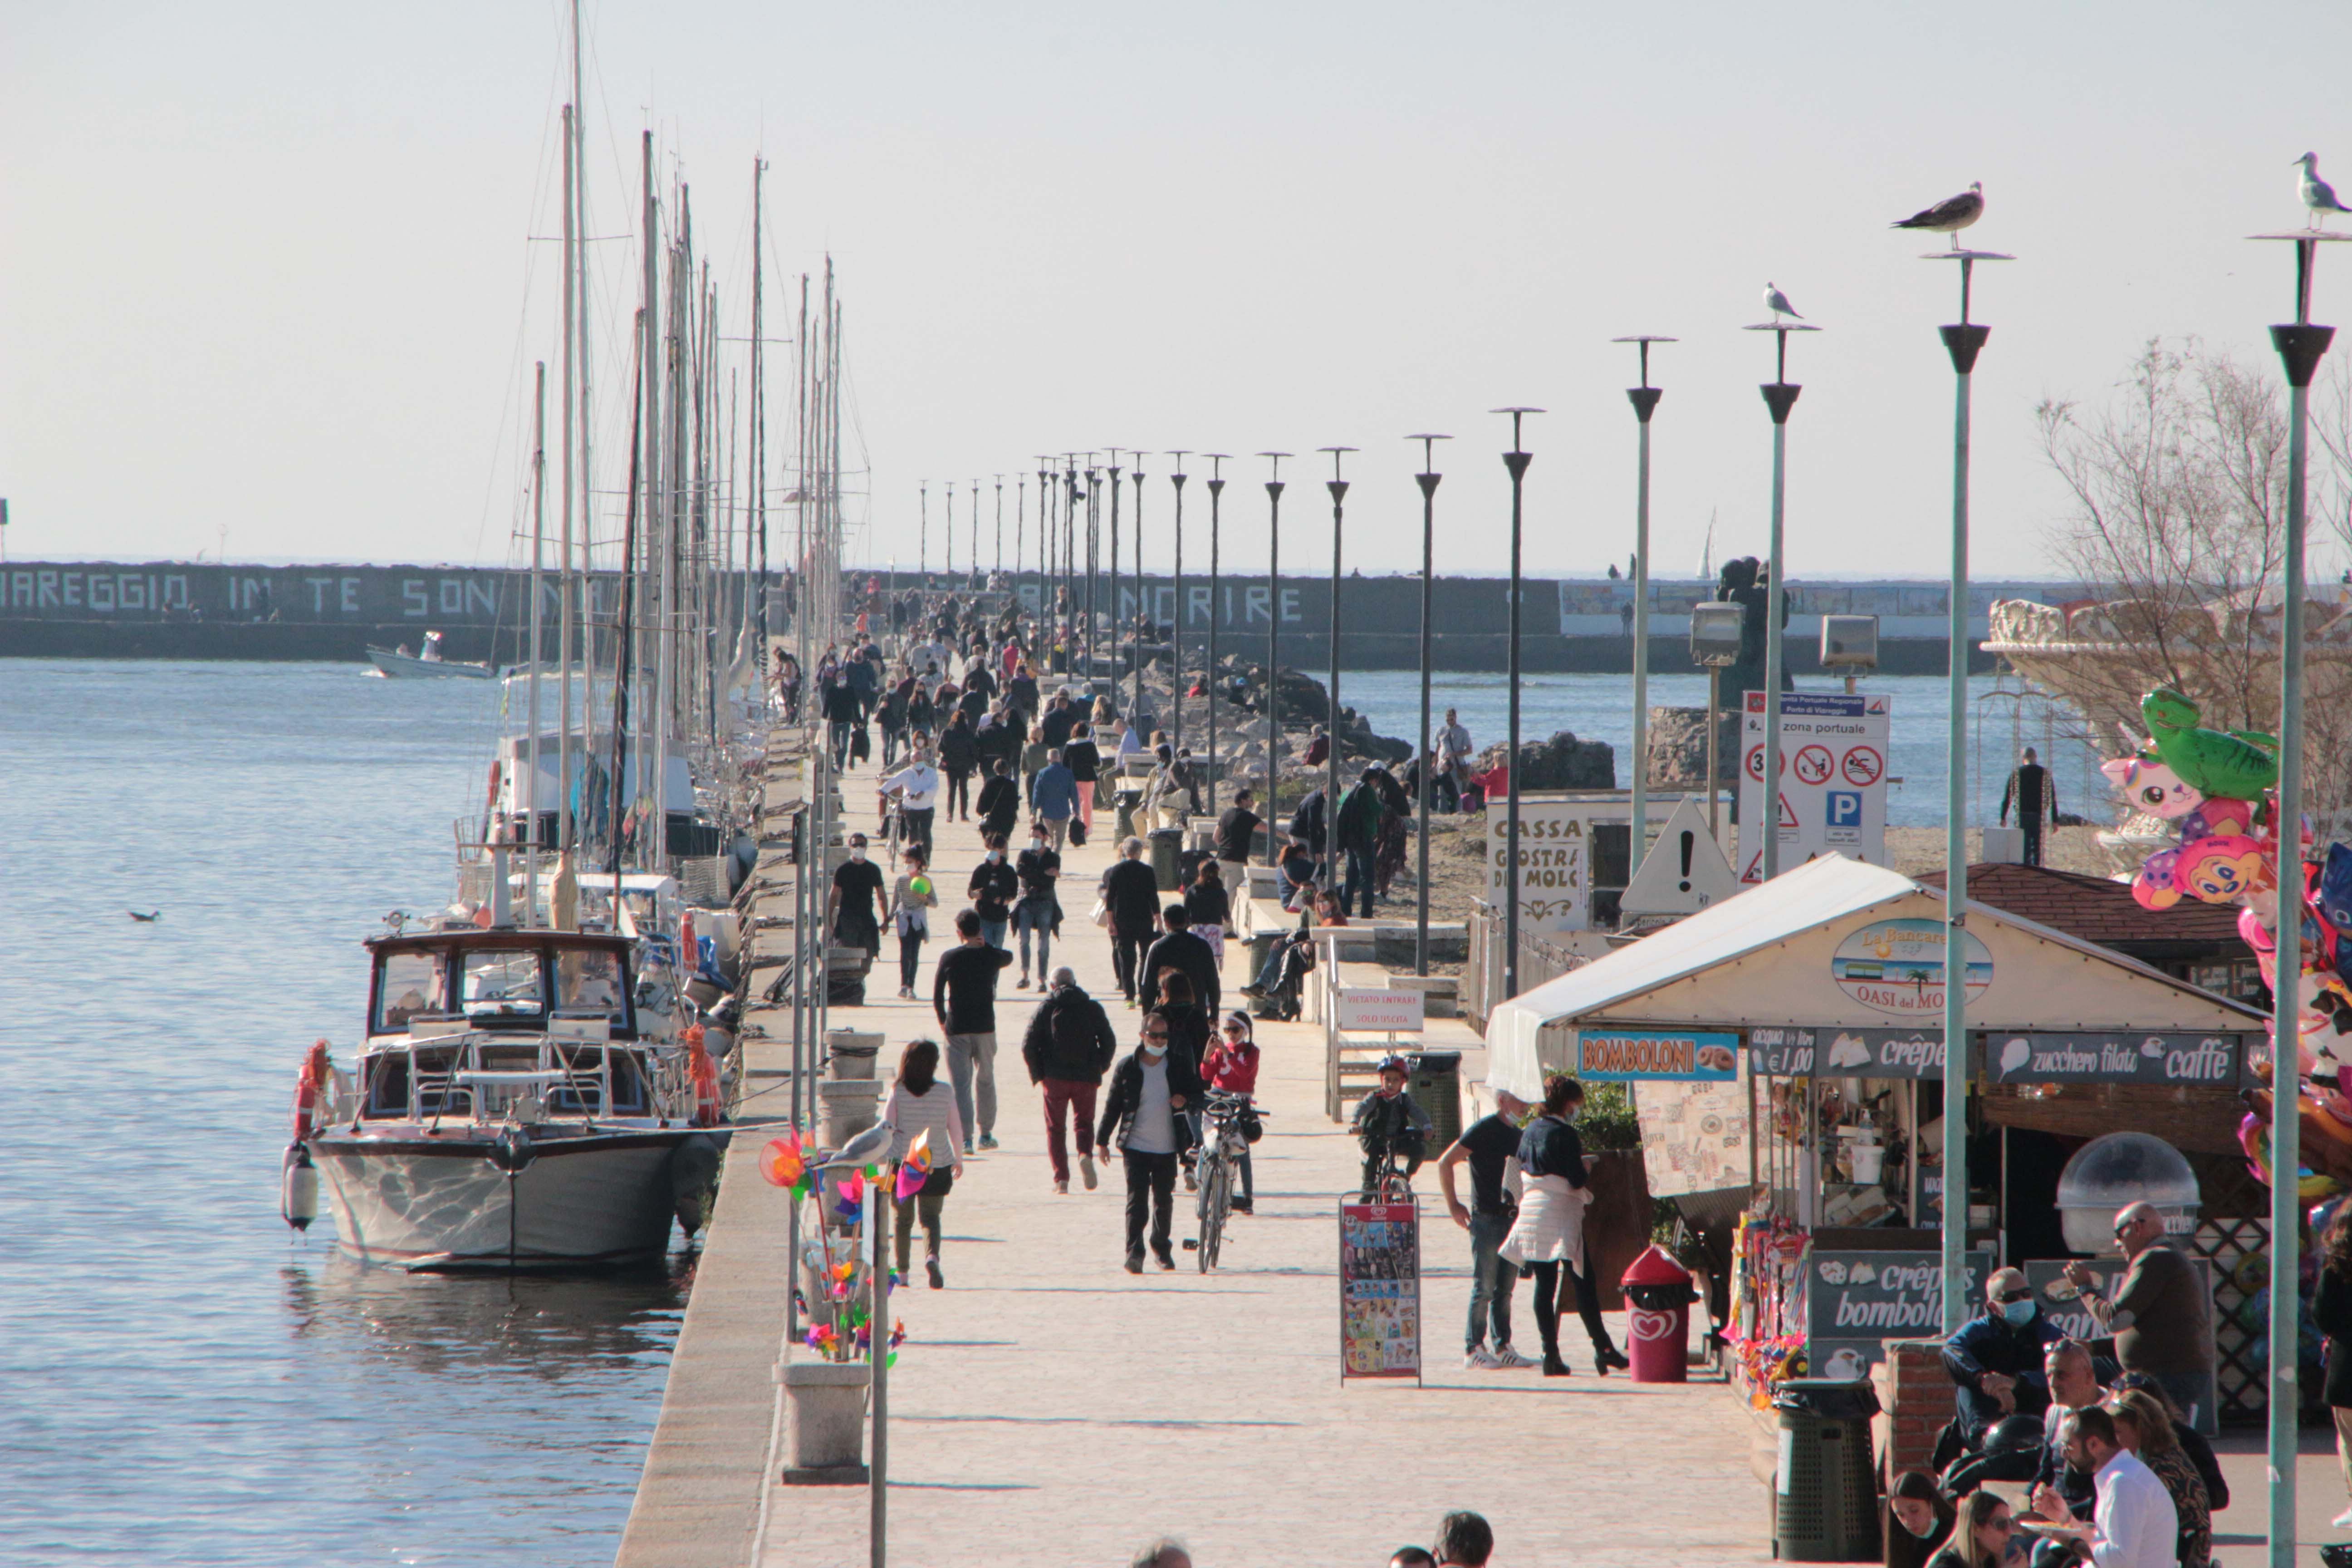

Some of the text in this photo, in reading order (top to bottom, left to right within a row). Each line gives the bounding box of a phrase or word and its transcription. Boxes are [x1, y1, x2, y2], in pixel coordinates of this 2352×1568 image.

[229, 577, 271, 610] IN
[305, 578, 361, 612] TE
[404, 579, 495, 616] SON
[1815, 707, 1847, 716] Viareggio
[1783, 723, 1865, 734] zona portuale
[1753, 753, 1764, 772] 3
[1835, 794, 1857, 823] P
[1494, 820, 1583, 838] CASSA
[1495, 849, 1579, 867] GOSTRA
[1862, 927, 1947, 946] La Bancare
[1348, 995, 1416, 1004] VIETATO ENTRARE
[1857, 986, 1896, 1007] OASI
[1899, 997, 1914, 1008] del
[1356, 1014, 1378, 1023] SOLO
[1753, 1029, 1784, 1051] acqua
[1583, 1039, 1695, 1074] BOMBOLONI
[1880, 1034, 1945, 1076] crêpe
[2033, 1043, 2137, 1073] zucchero filato
[1881, 1259, 1976, 1301] crêps
[1836, 1291, 1981, 1328] bomboloi
